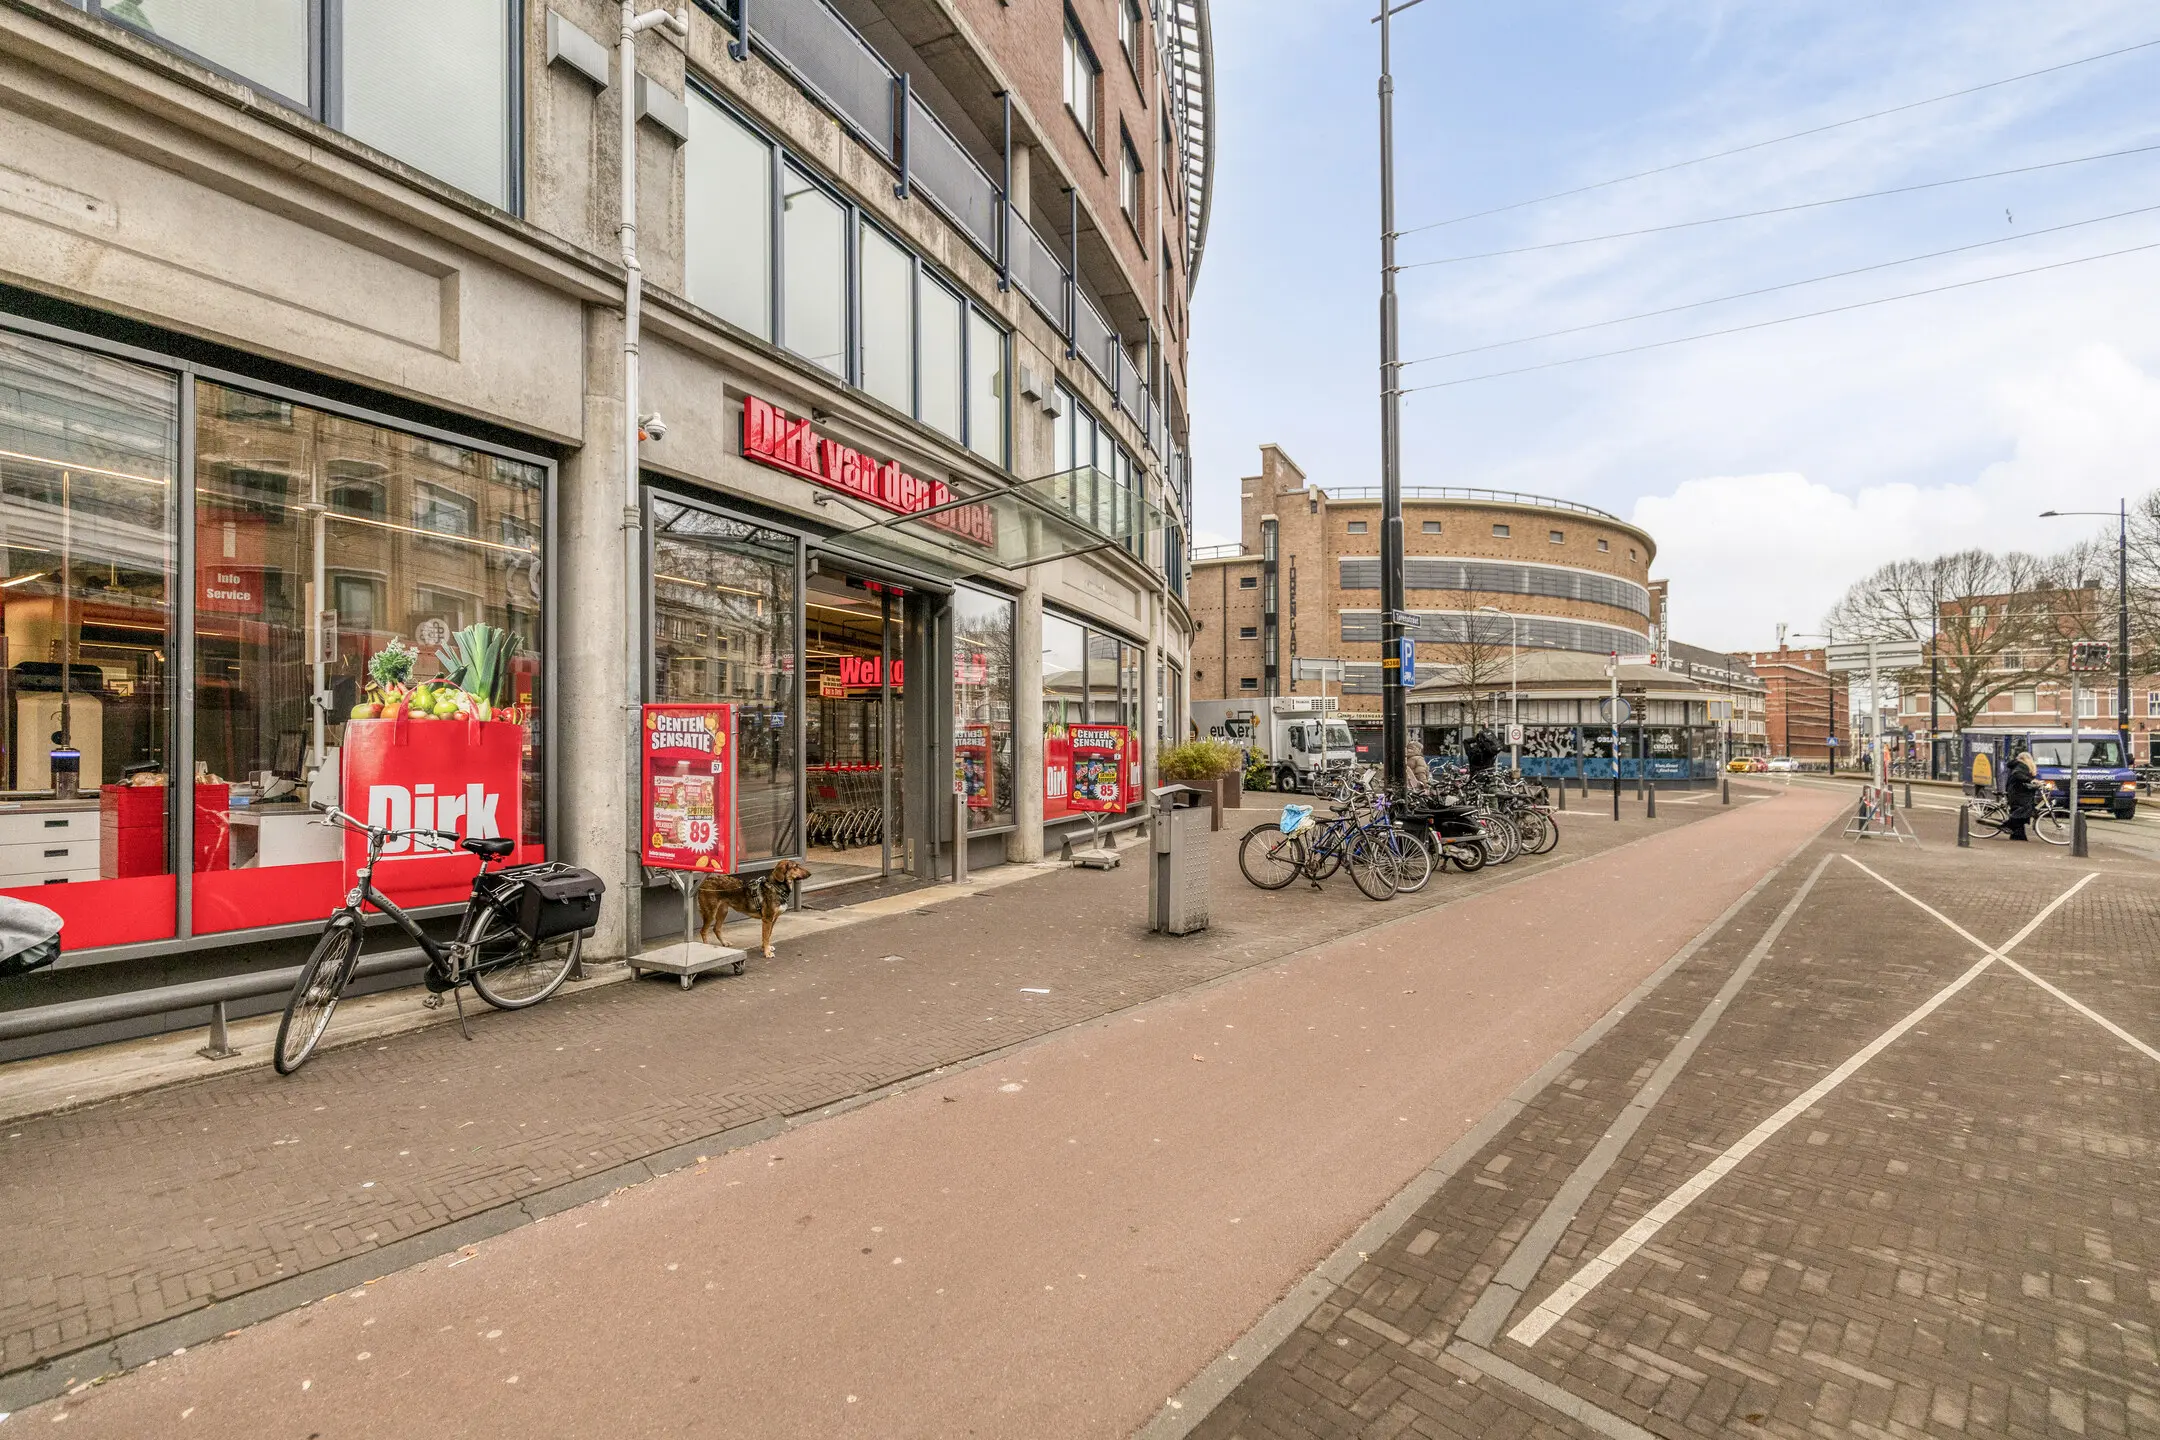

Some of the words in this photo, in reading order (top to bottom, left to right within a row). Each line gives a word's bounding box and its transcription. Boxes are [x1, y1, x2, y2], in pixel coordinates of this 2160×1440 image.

[745, 396, 820, 474] Dirk
[823, 439, 878, 496] van
[881, 460, 929, 511] den
[931, 481, 993, 543] Broek
[217, 573, 241, 584] Info
[206, 588, 251, 601] Service
[1404, 642, 1413, 666] P
[657, 714, 705, 732] CENTEN
[651, 732, 711, 753] SENSATIE
[1073, 738, 1114, 749] SENSATIE
[1077, 729, 1110, 739] CENTEN
[1047, 766, 1068, 796] Dirk
[1100, 785, 1114, 797] 85
[367, 783, 501, 854] Dirk
[689, 821, 710, 844] 89
